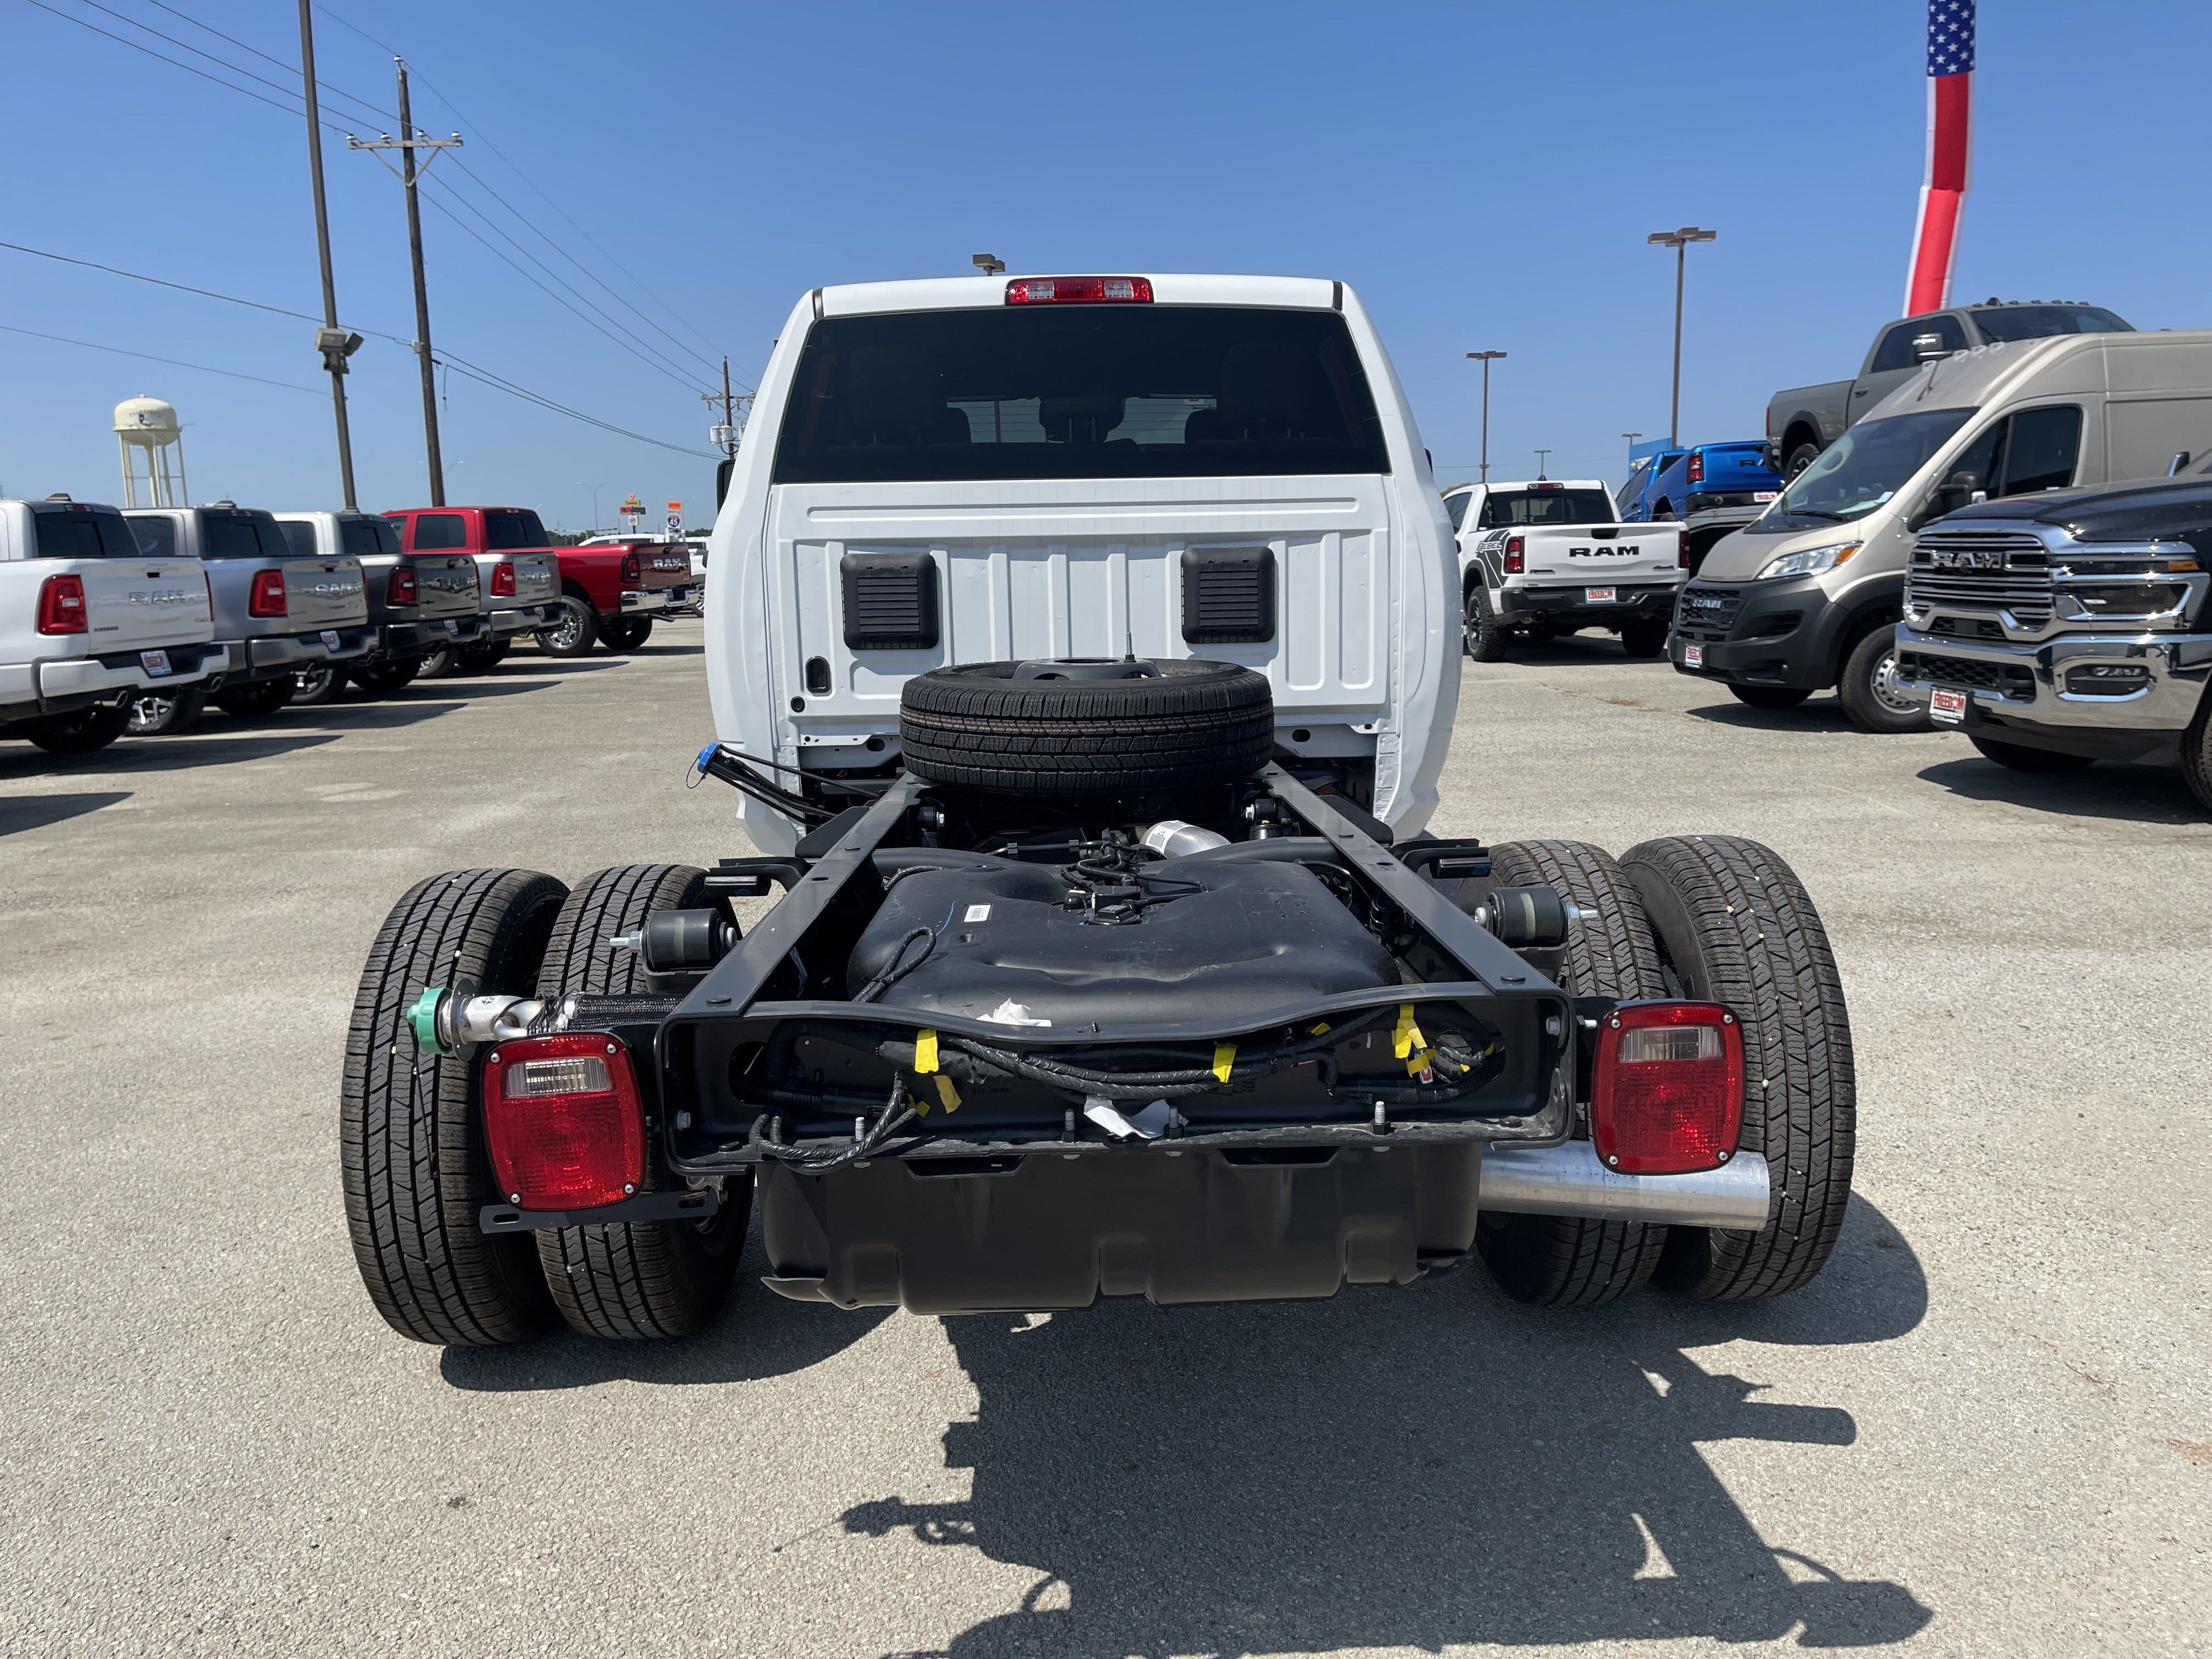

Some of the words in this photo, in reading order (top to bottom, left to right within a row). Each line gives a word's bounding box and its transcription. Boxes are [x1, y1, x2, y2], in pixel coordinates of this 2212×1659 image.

[1476, 540, 1503, 553] REBEL
[1569, 546, 1640, 557] RAM
[653, 558, 681, 568] RAM
[1932, 550, 2002, 568] RAM
[129, 589, 185, 605] RAM
